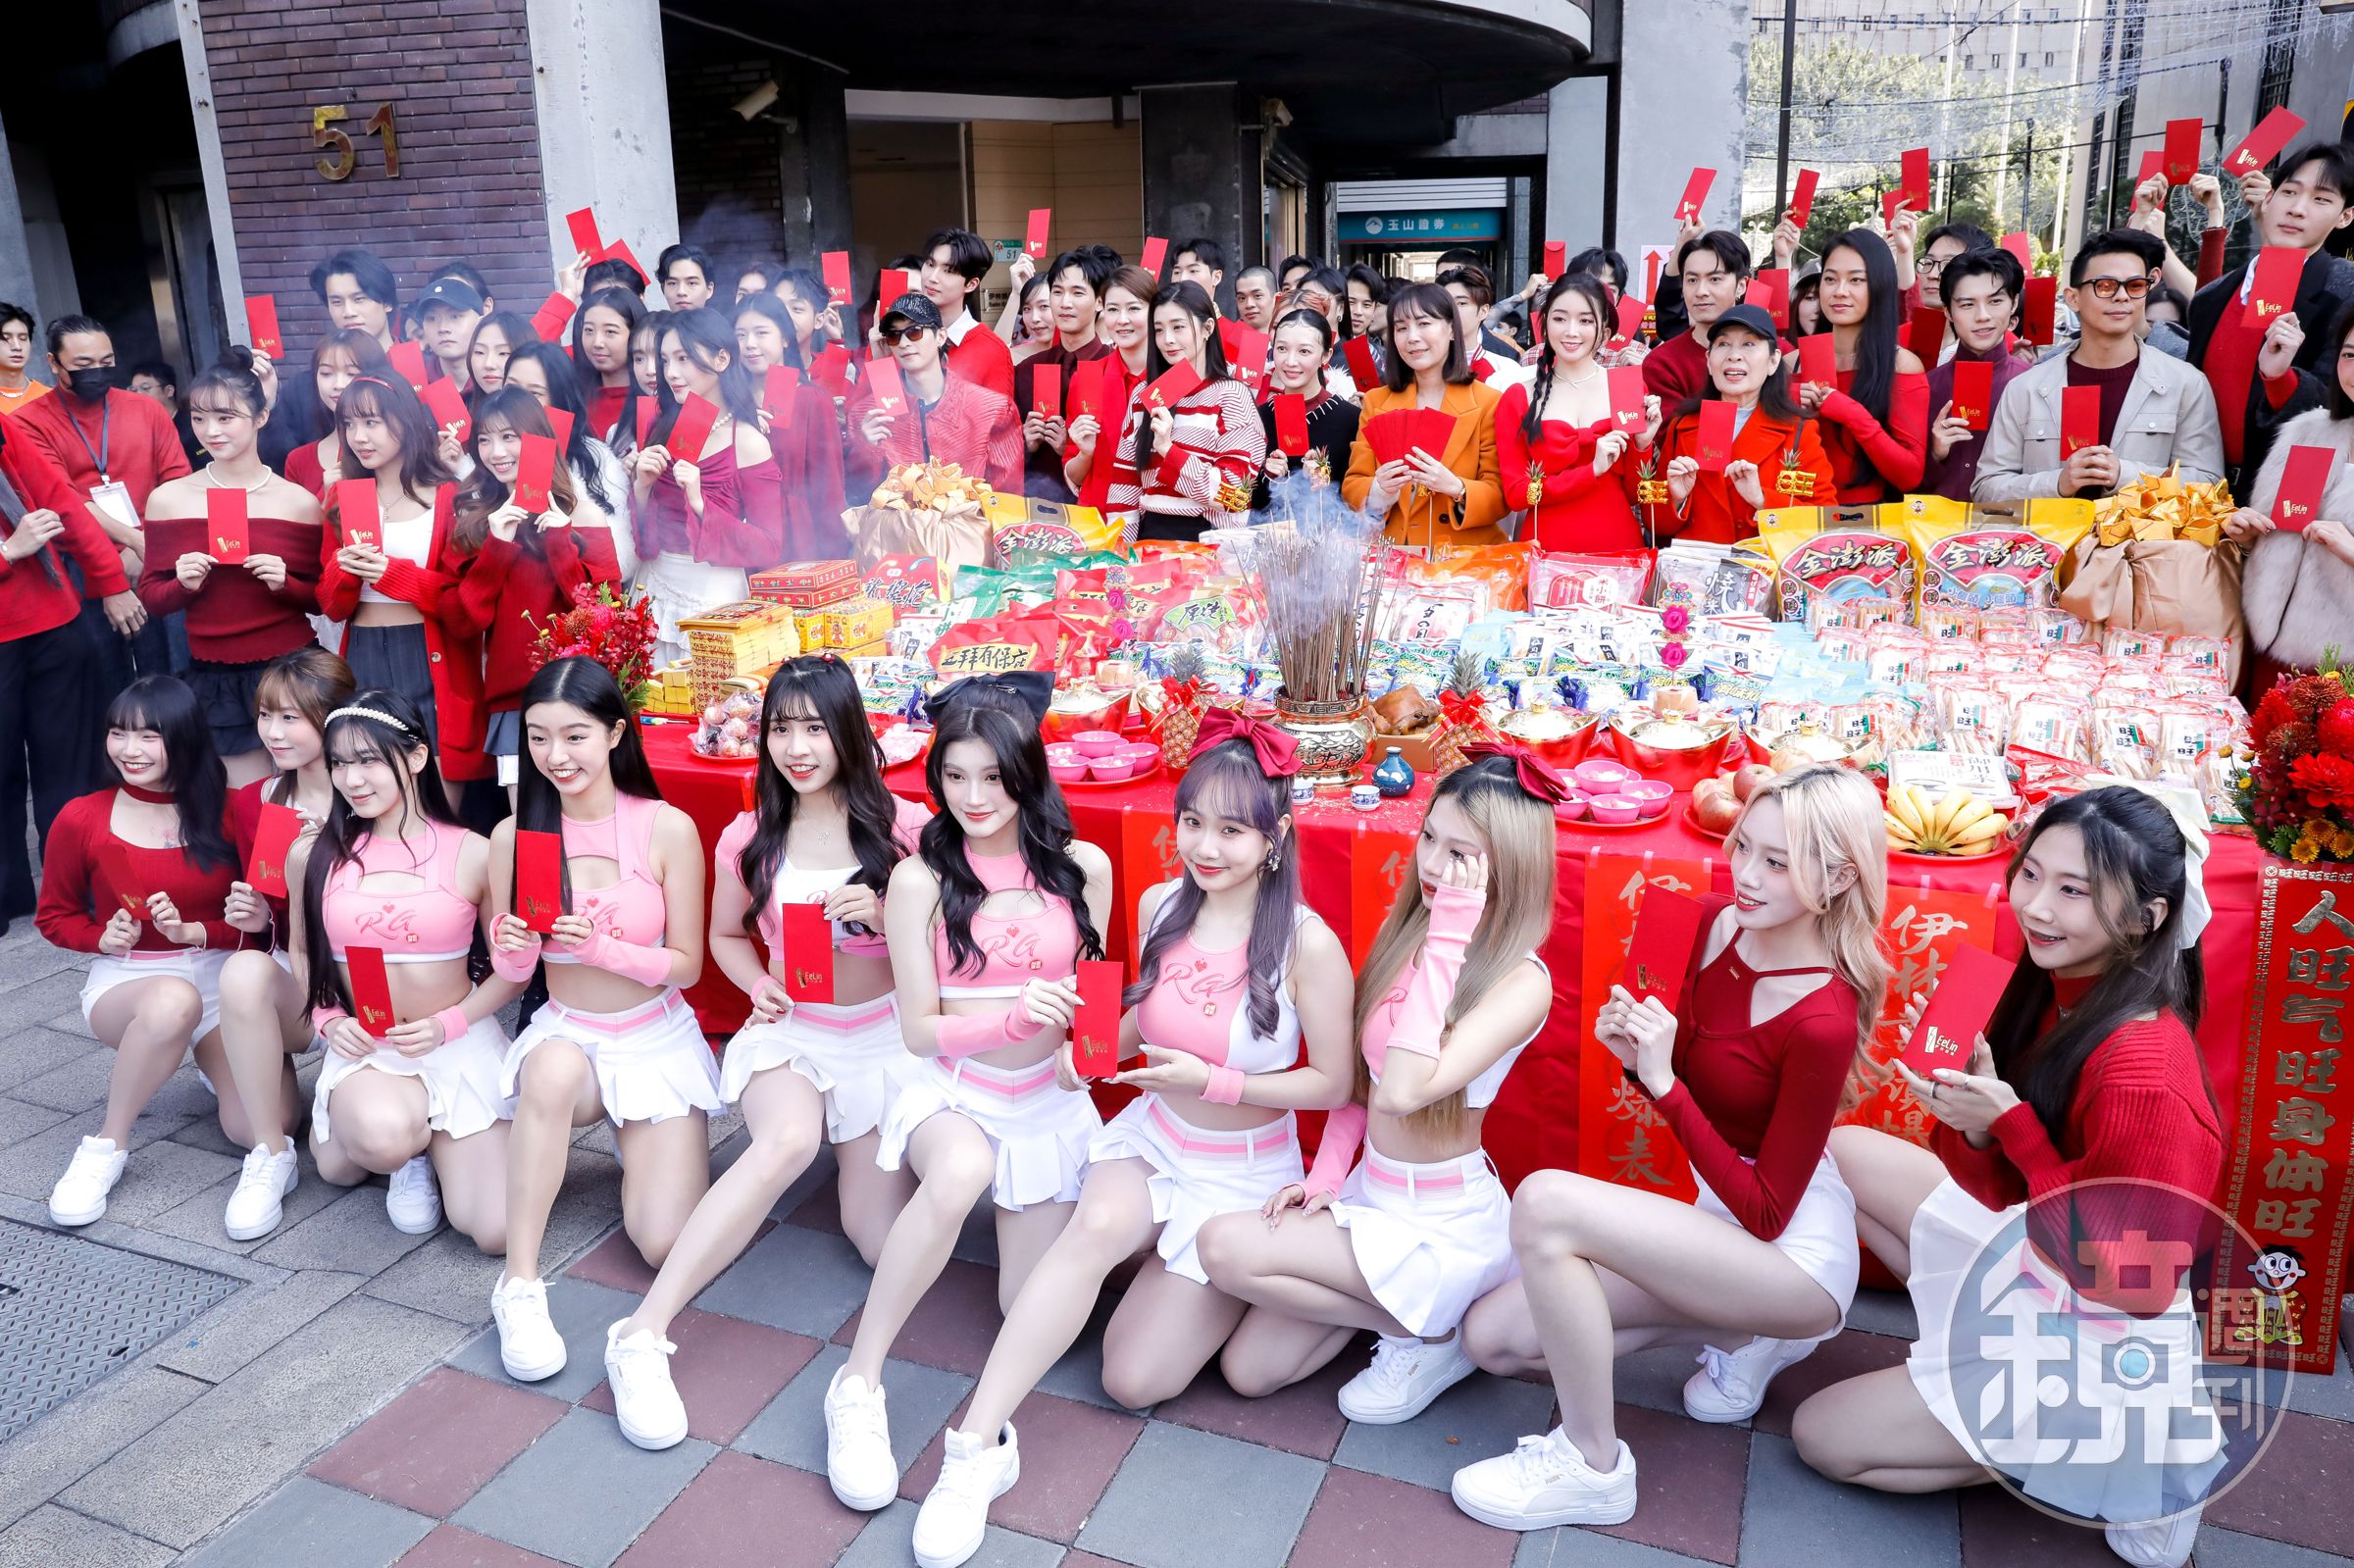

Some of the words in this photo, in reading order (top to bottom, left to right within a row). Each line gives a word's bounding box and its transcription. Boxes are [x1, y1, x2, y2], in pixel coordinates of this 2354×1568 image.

[313, 102, 401, 182] 51
[1387, 218, 1446, 231] 玉山證券
[1006, 249, 1017, 260] 51
[1936, 1035, 1959, 1052] EeLin
